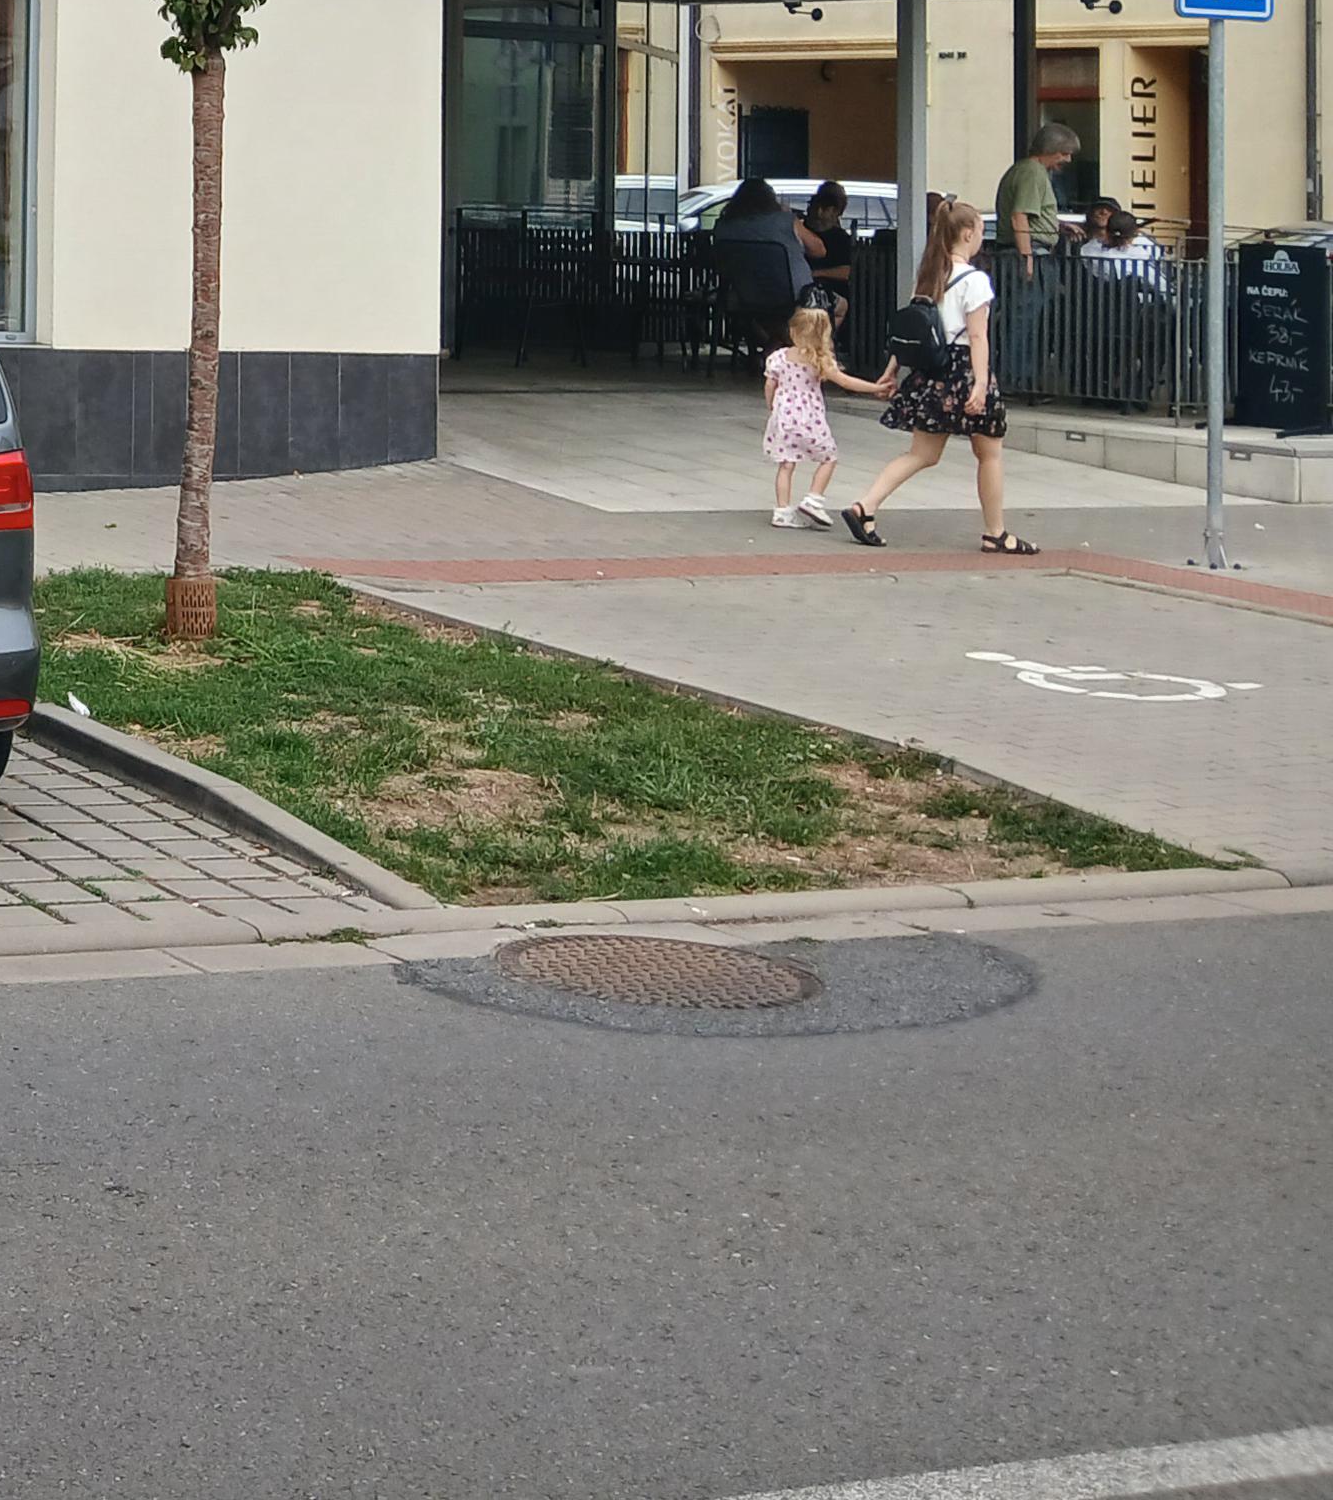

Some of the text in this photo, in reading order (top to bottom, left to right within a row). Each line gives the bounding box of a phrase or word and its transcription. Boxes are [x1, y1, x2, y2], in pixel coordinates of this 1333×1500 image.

[1130, 76, 1157, 211] TELIER
[1263, 260, 1300, 275] HOLBA
[1247, 286, 1260, 296] NA
